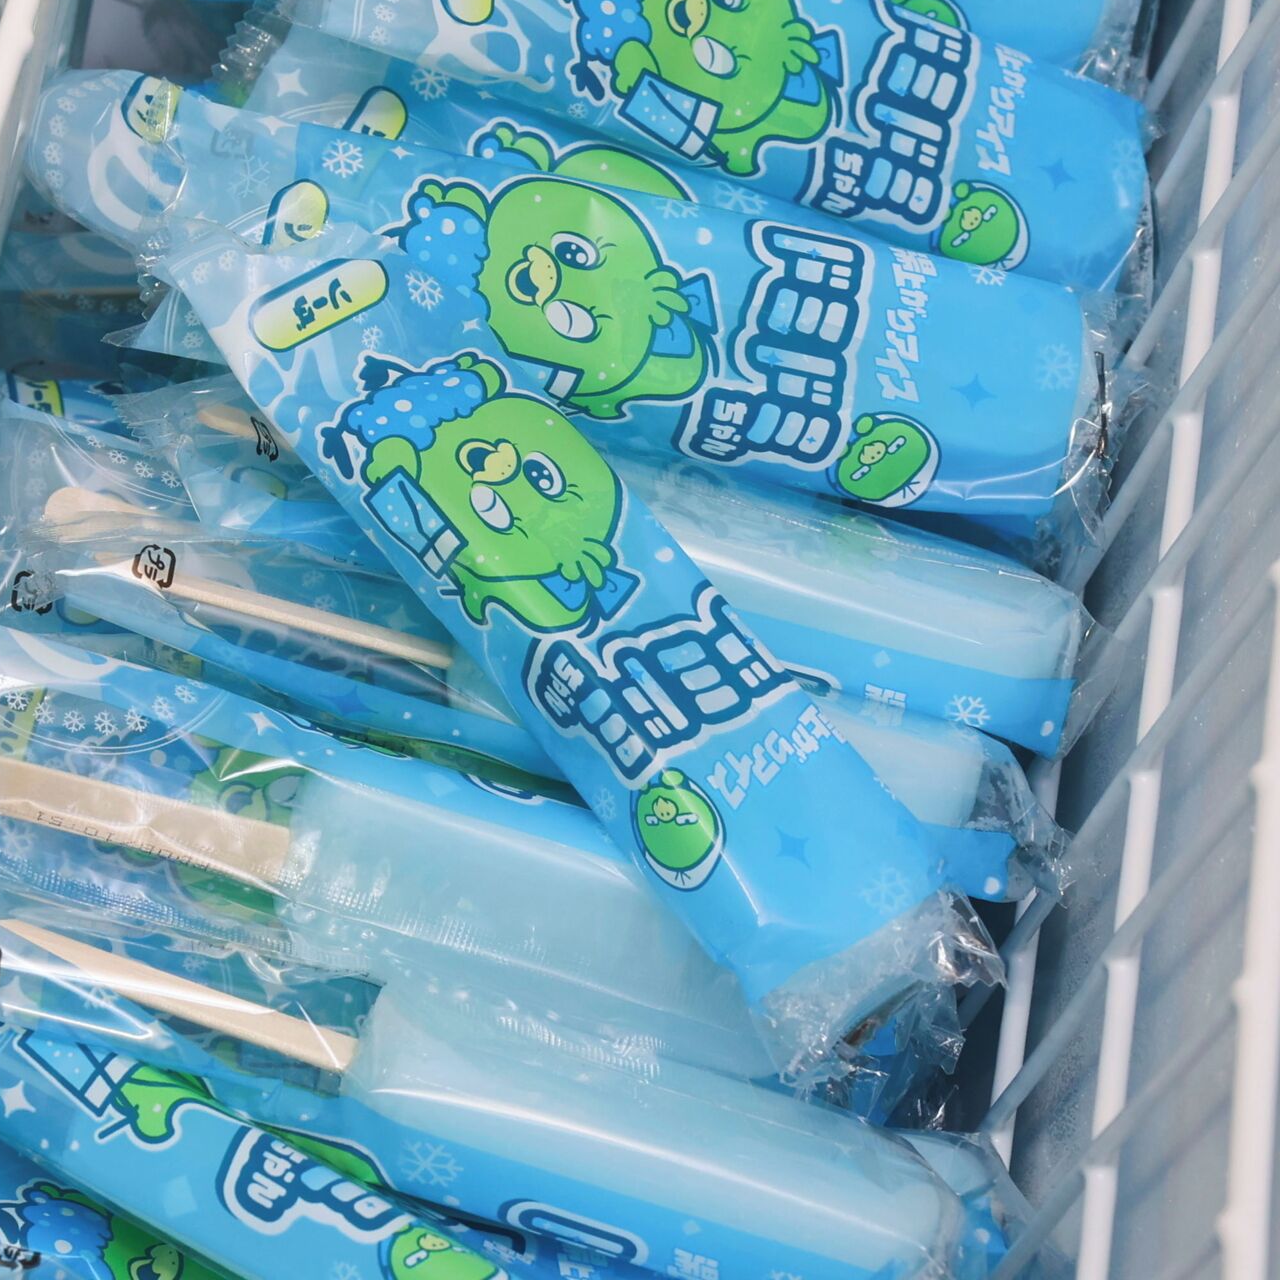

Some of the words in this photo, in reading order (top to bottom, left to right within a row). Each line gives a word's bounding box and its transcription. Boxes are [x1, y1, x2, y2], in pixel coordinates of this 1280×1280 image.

[865, 4, 963, 216] ドミドミ
[820, 148, 865, 215] ちゃん
[293, 277, 353, 333] ソーダ
[746, 232, 856, 456] ドミドミ
[873, 246, 939, 404] 湯上がりアイス
[700, 398, 748, 457] ちゃん
